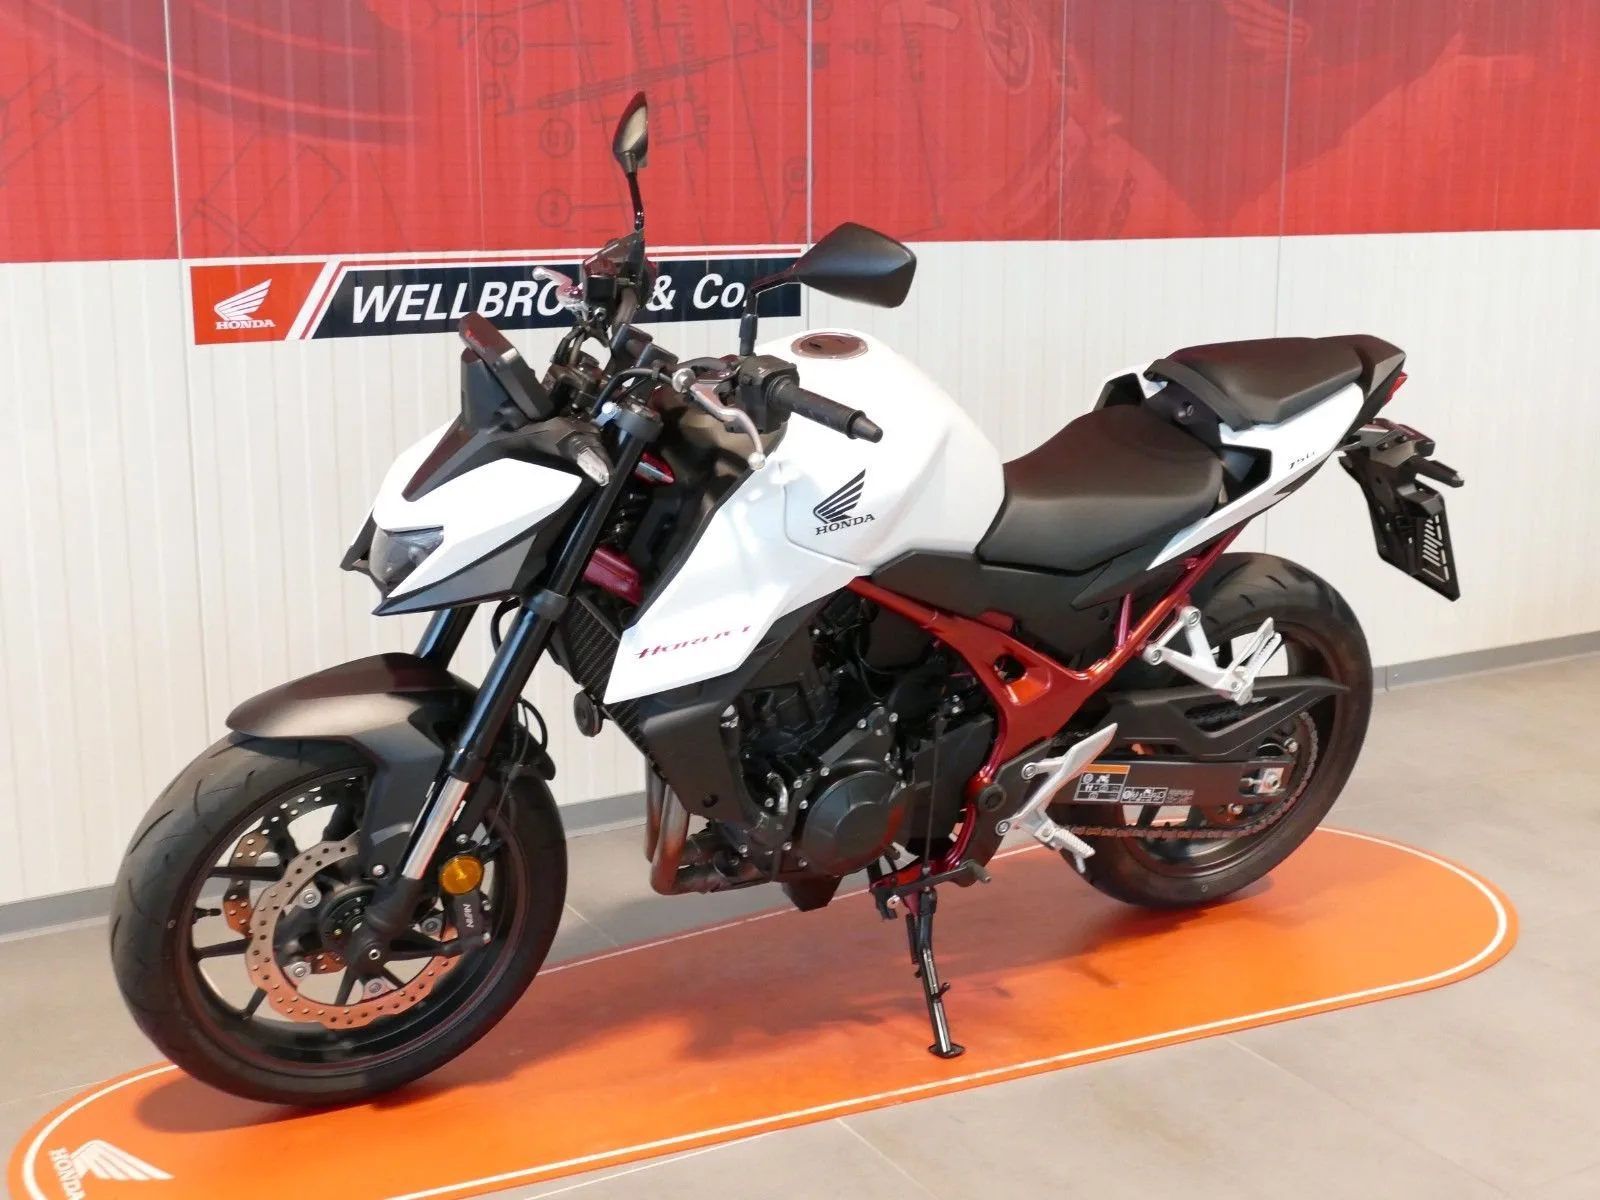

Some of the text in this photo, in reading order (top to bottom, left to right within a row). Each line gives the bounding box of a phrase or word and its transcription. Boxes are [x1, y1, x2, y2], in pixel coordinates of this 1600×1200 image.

[352, 280, 565, 324] WELLBRO
[645, 274, 676, 311] &
[215, 319, 276, 330] HONDA
[815, 513, 876, 536] HONDA
[49, 1147, 86, 1200] HONDA
